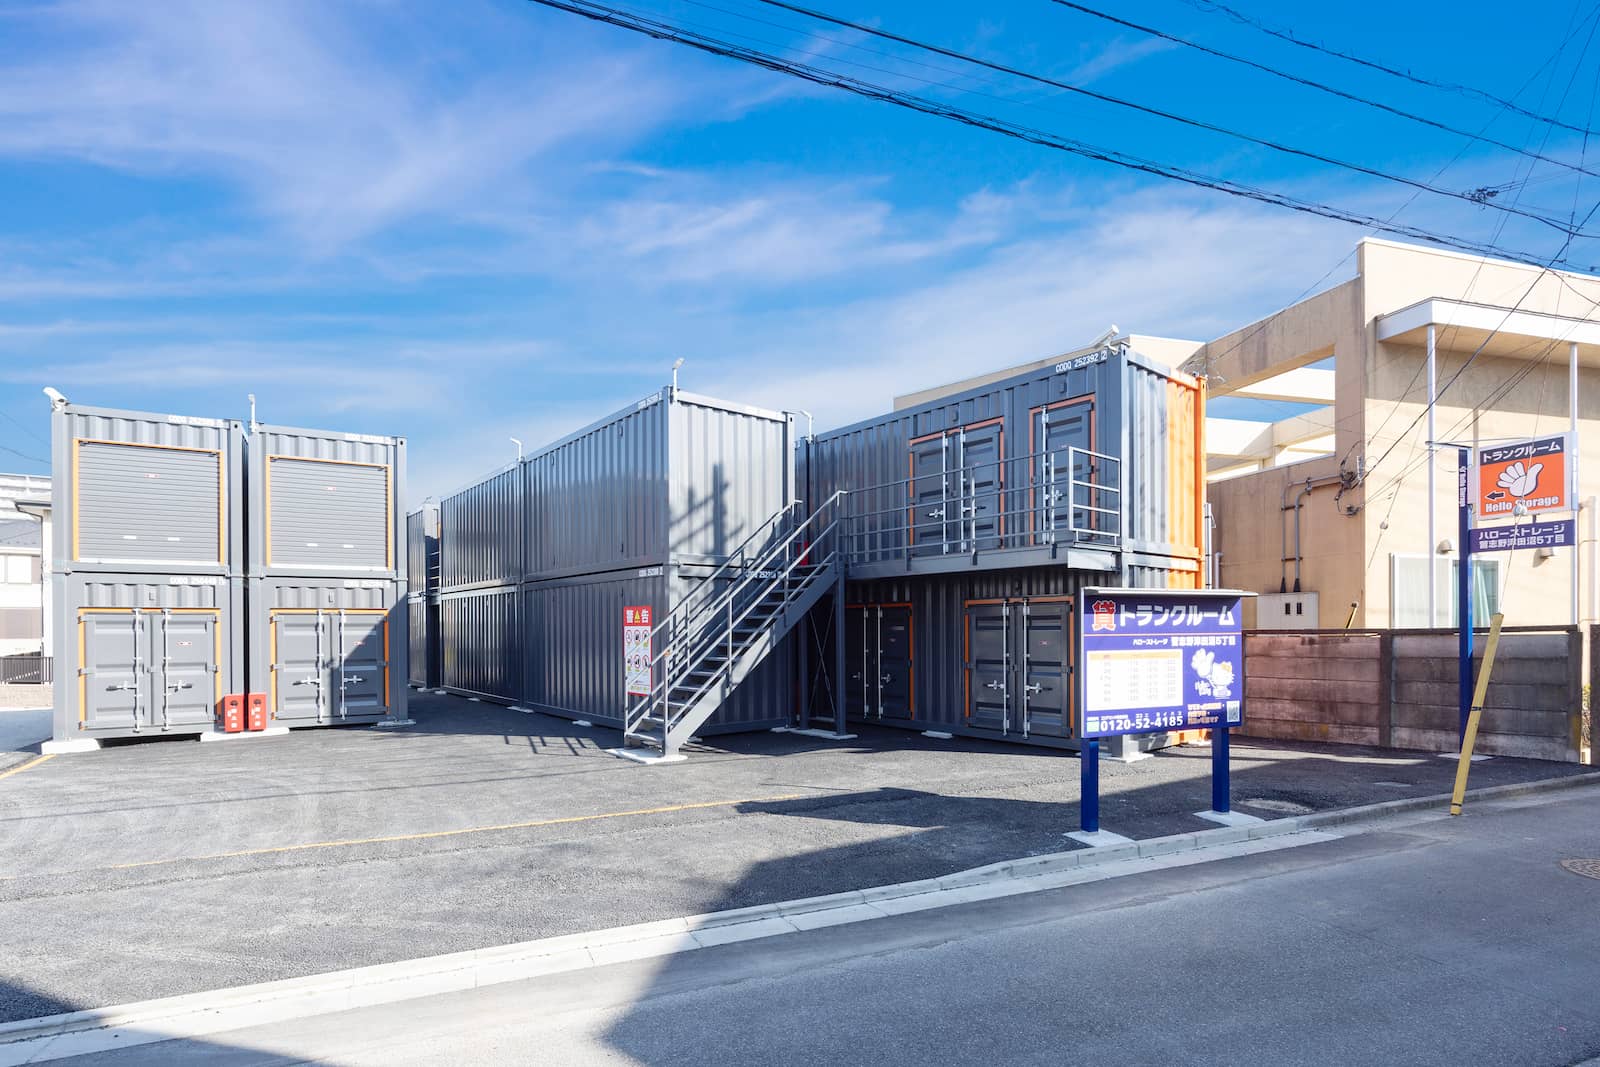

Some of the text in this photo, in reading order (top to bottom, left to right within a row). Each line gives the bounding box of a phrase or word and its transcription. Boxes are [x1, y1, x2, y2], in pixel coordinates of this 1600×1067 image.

[1483, 441, 1561, 463] トランクルーム
[1485, 502, 1513, 513] Hello
[1479, 524, 1565, 540] ハローストレージ
[1100, 715, 1184, 732] 0120-52-4185
